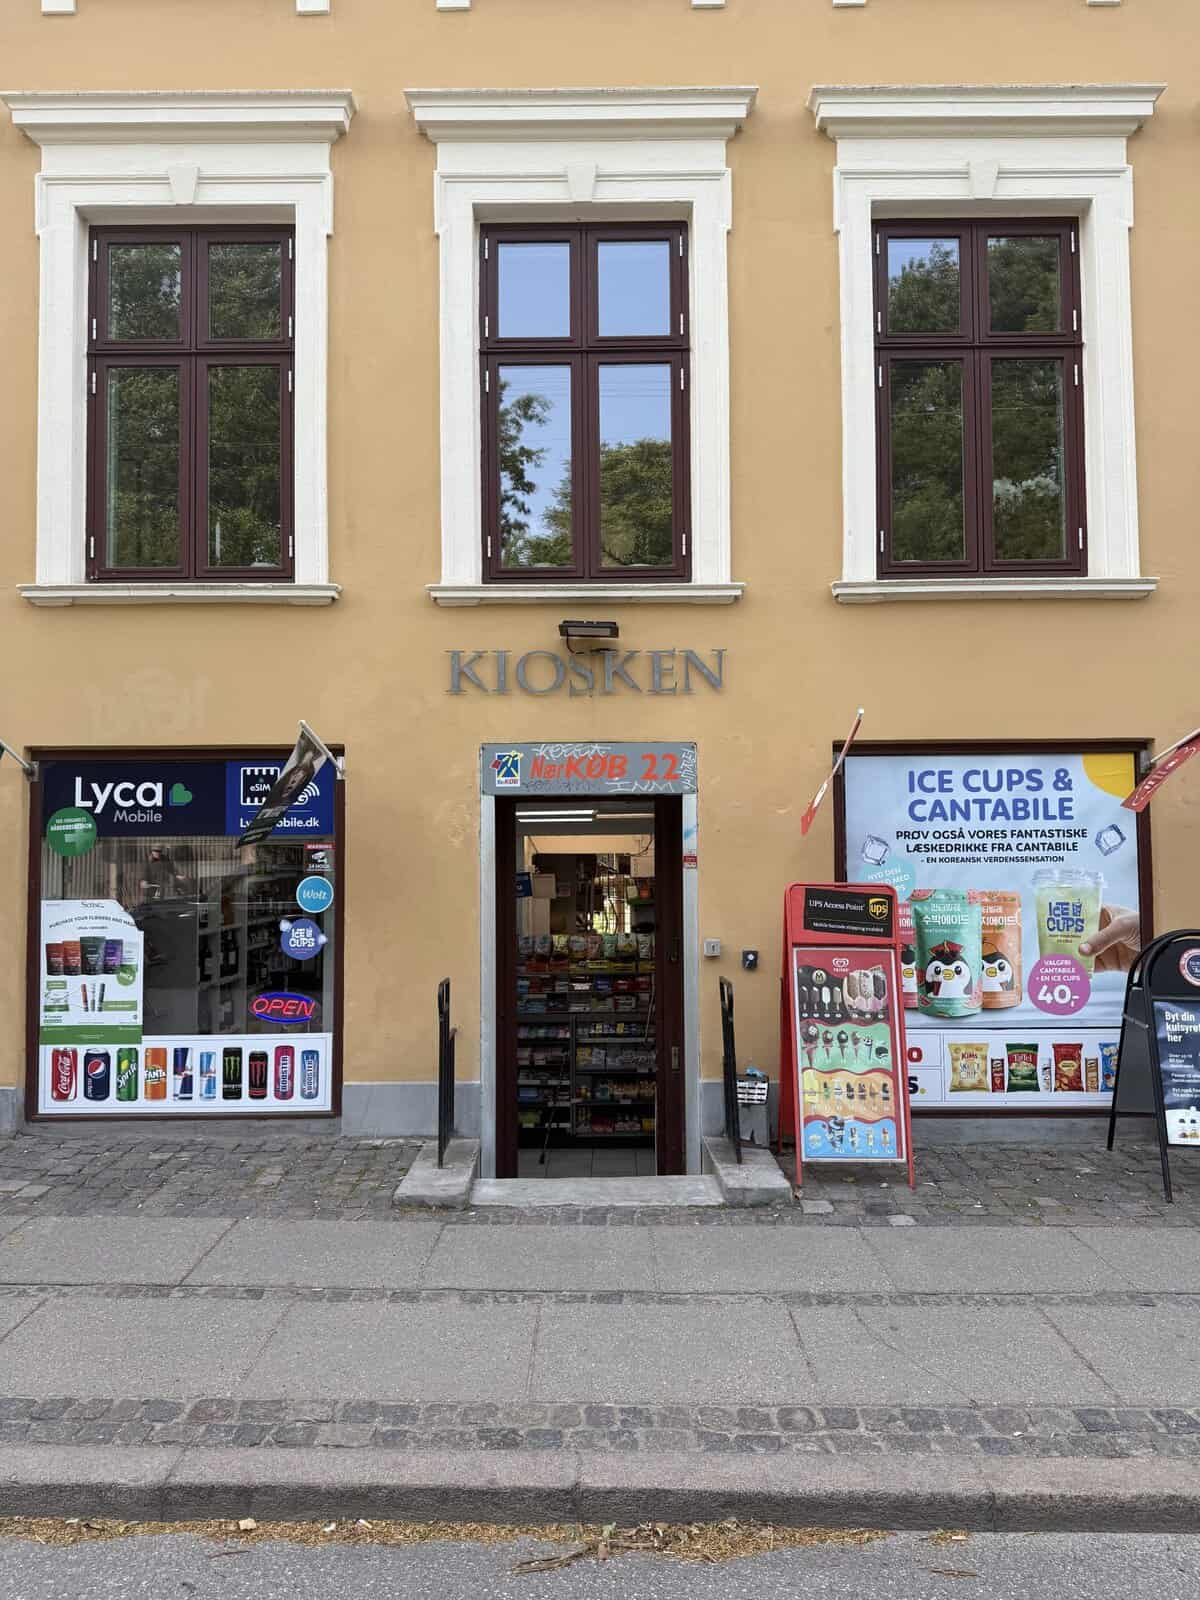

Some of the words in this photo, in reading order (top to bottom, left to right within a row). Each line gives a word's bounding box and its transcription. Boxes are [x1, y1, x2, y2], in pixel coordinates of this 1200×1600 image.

[443, 648, 728, 697] KIOSKEN
[640, 753, 681, 780] 22
[249, 783, 271, 792] eSIM
[908, 769, 954, 793] ICE
[962, 768, 1044, 793] CUPS
[1052, 768, 1073, 792] &
[75, 776, 163, 814] Lyca
[113, 809, 163, 823] Mobile
[908, 797, 1074, 822] CANTABILE
[896, 830, 930, 840] PRØV
[932, 827, 966, 840] OGSÅ
[967, 829, 1008, 840] VORES
[1010, 828, 1088, 839] FANTASTISKE
[906, 843, 988, 853] LÆSKEDRIKKE
[991, 842, 1013, 852] FRA
[1015, 842, 1079, 852] CANTABILE
[302, 889, 327, 900] Wolt
[871, 903, 888, 916] ups
[1048, 902, 1070, 917] ICE
[1047, 917, 1085, 933] CUPS
[291, 928, 306, 938] ICE
[289, 938, 315, 948] CUPS
[1038, 984, 1080, 1007] 40,-
[253, 998, 316, 1016] OPEN
[1165, 1011, 1179, 1022] Byt
[1181, 1012, 1195, 1021] din
[1167, 1033, 1183, 1042] her
